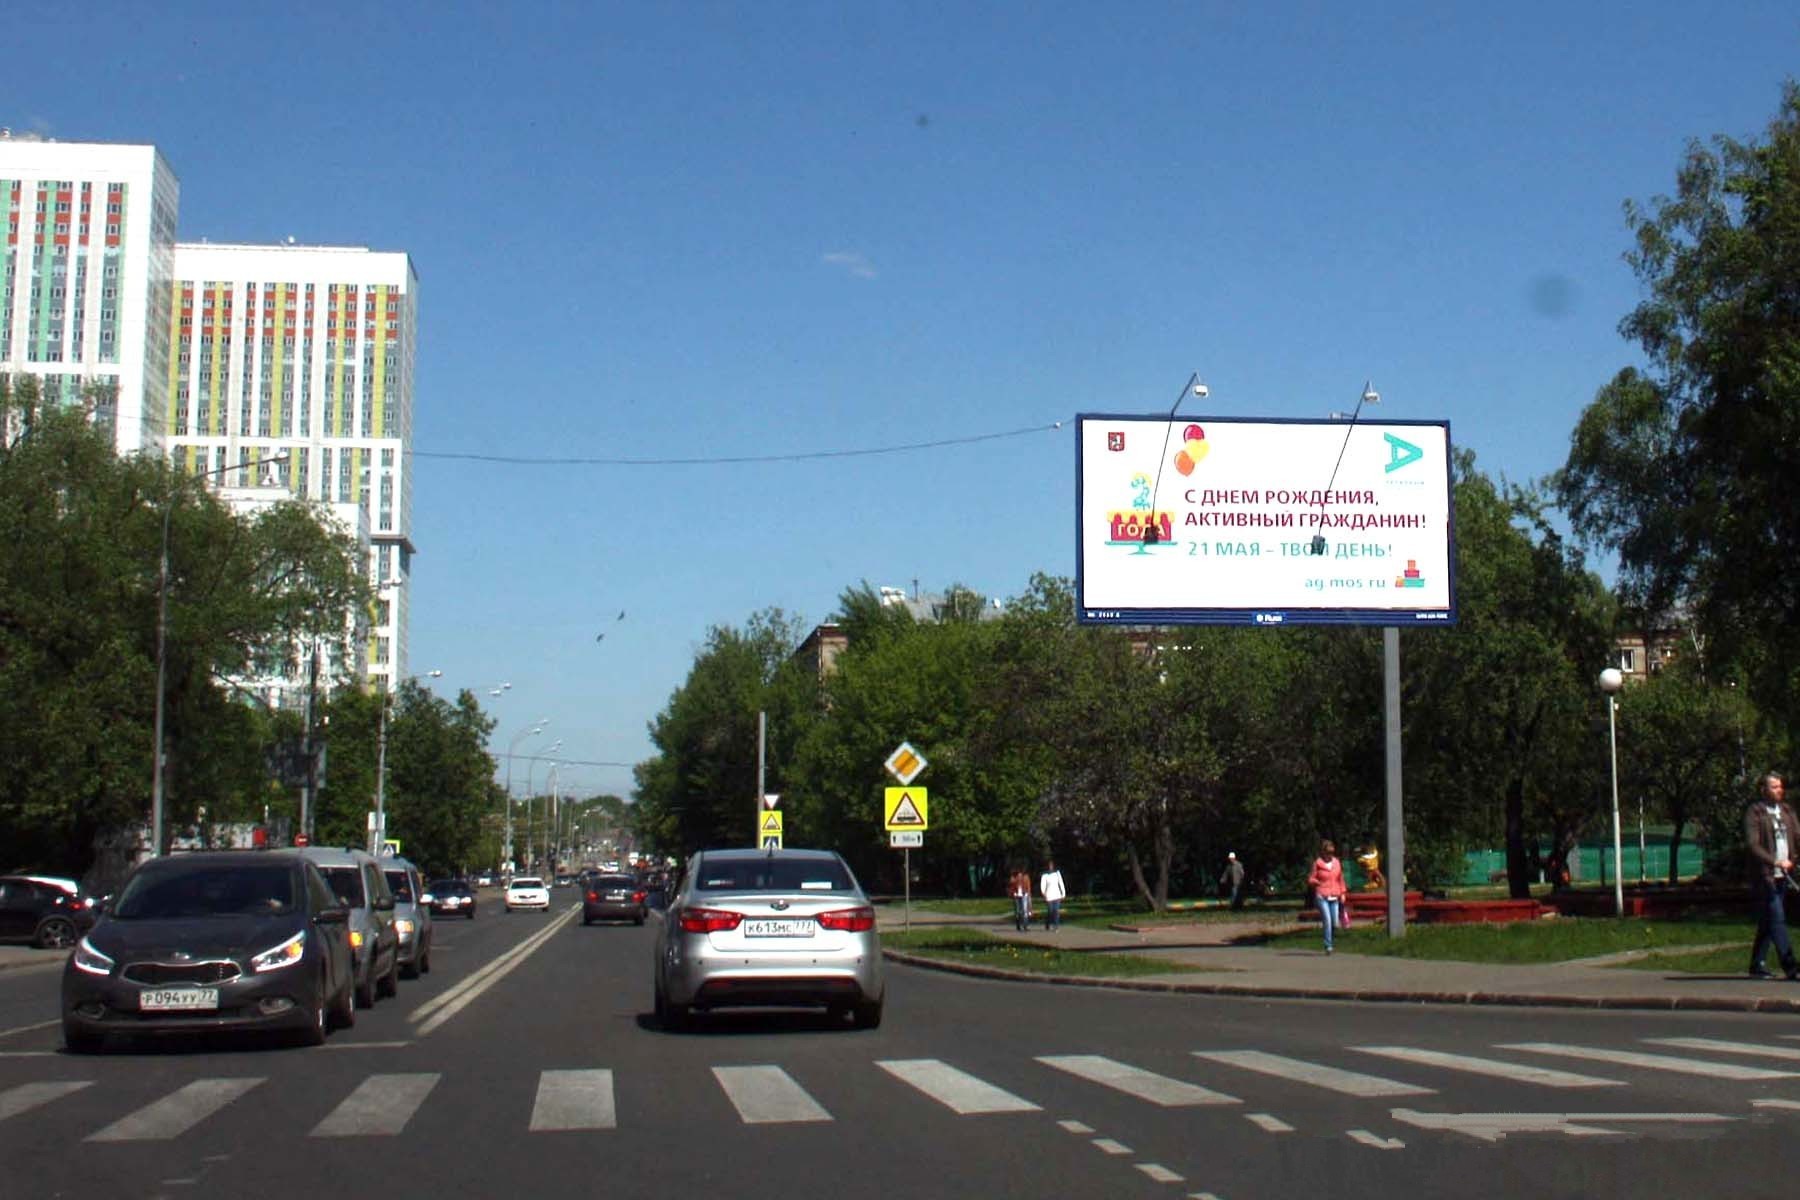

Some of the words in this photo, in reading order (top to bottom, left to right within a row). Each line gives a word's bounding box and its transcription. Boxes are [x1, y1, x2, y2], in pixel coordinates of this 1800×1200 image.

[1184, 489, 1196, 504] С
[1201, 489, 1259, 507] ДНЕМ
[1265, 490, 1379, 507] РОЖДЕНИЯ,
[1184, 510, 1293, 528] АКТИВНЫЙ
[1300, 513, 1426, 531] ГРАЖДАНИН!
[1188, 541, 1208, 556] 21
[1216, 542, 1260, 556] МАЯ
[1335, 543, 1392, 560] ДЕНЬ!
